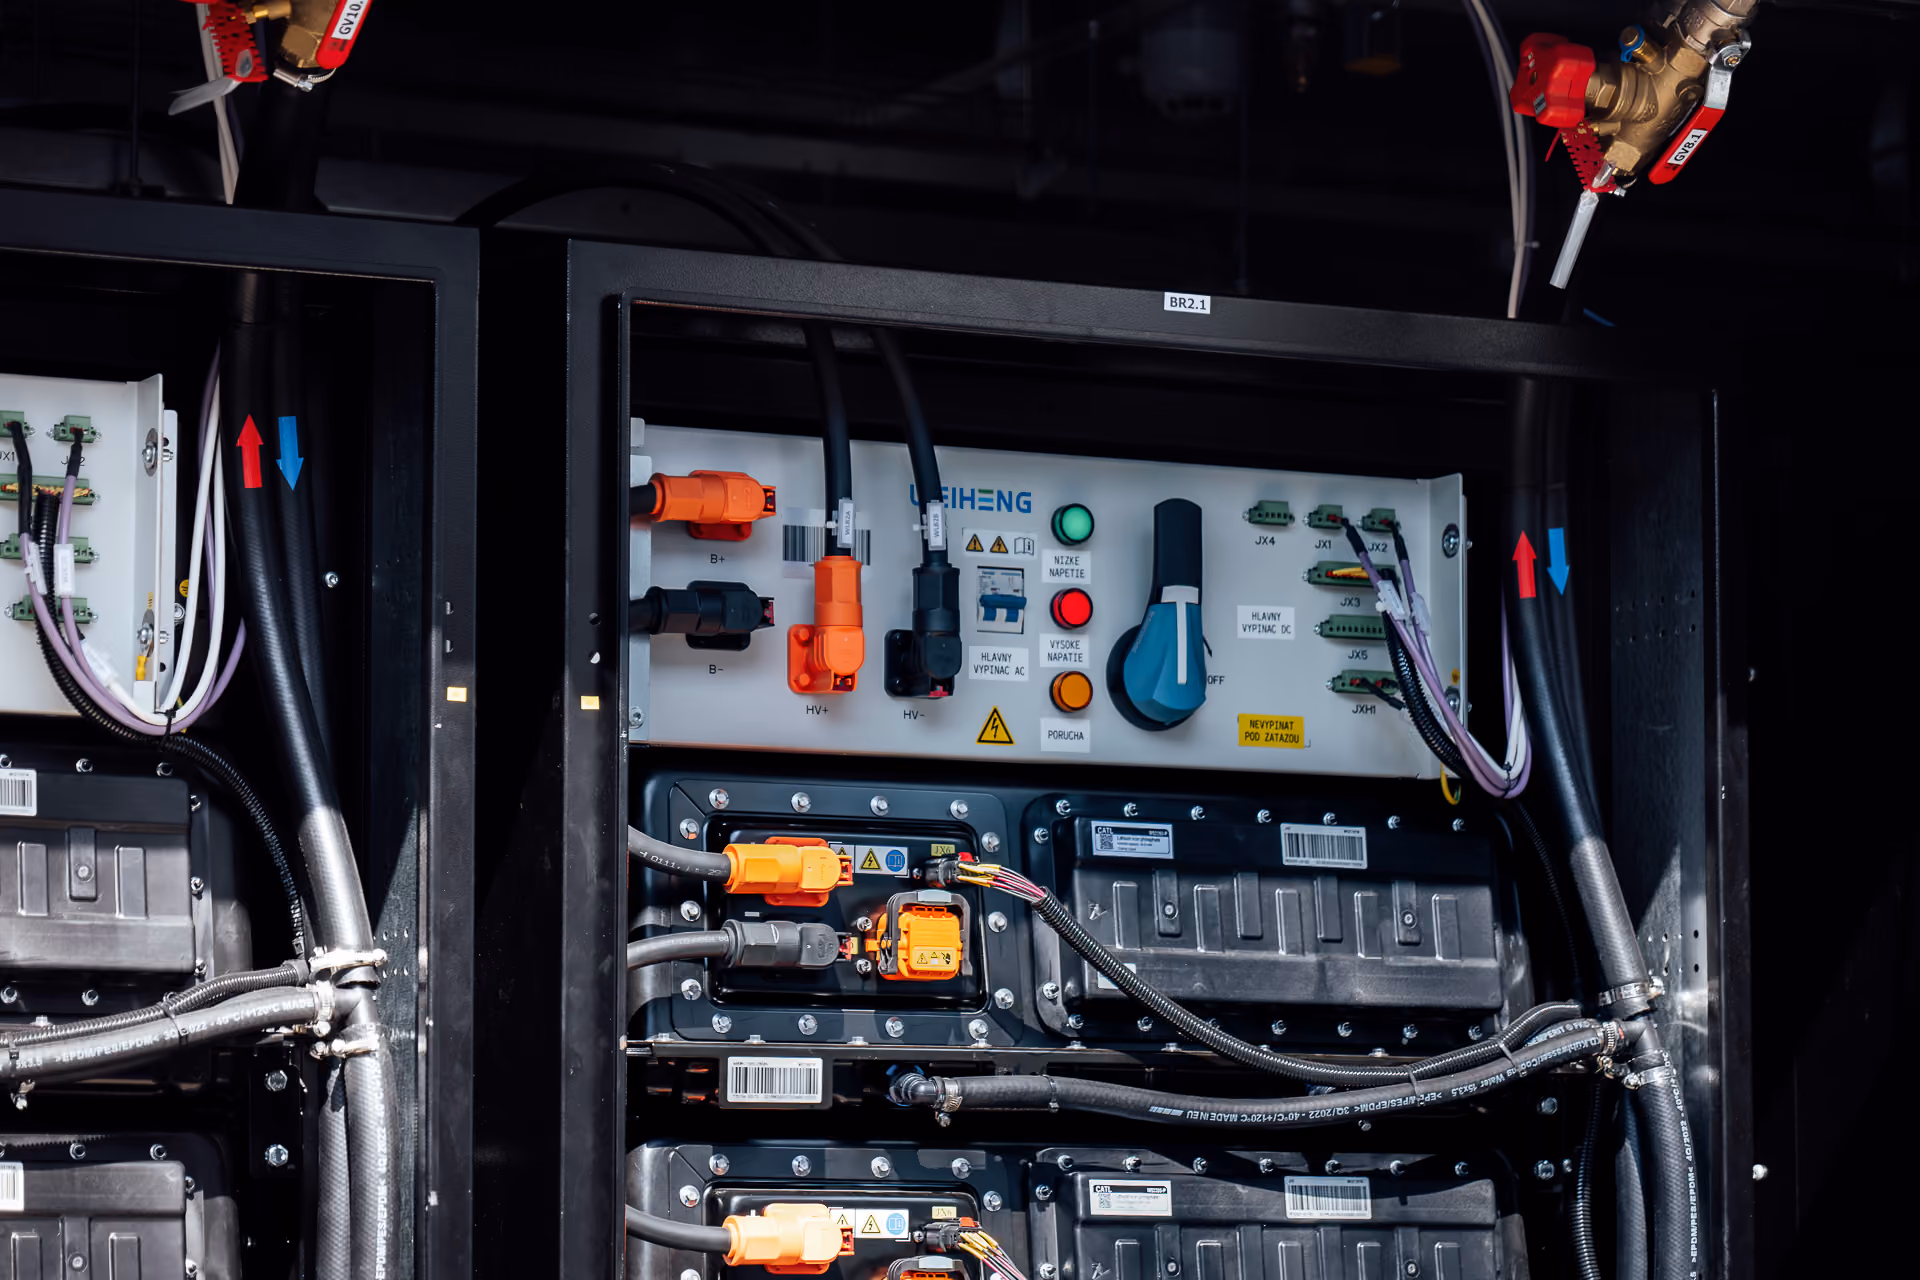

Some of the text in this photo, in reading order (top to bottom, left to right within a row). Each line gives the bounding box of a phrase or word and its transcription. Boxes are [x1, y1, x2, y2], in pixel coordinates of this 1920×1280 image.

[1674, 134, 1703, 162] GV8.1
[1170, 296, 1207, 311] BR2.1
[60, 455, 86, 467] J2
[1255, 536, 1276, 546] JX4
[1315, 540, 1332, 550] JX1
[1368, 543, 1388, 553] JX2
[710, 554, 725, 564] B+
[1054, 555, 1080, 566] NIZKE
[1049, 568, 1085, 579] NAPETIE
[1340, 598, 1361, 608] JX3
[1252, 612, 1281, 622] HLAVNY
[1242, 624, 1291, 635] VYPINAC DC
[1049, 640, 1081, 650] VYSOKE
[981, 652, 1012, 663] HLAVNY
[1047, 652, 1083, 662] NAPATIE
[1348, 650, 1368, 660] JX5
[973, 664, 1025, 676] VYPINAC AC
[1207, 675, 1225, 685] OFF
[806, 705, 829, 715] HV+
[1352, 705, 1376, 715] JXH1
[1249, 720, 1294, 731] NEVYPINAT
[1047, 729, 1084, 741] PORUCHA
[1245, 732, 1300, 744] POD ZATAZOU
[1097, 827, 1114, 835] CATL
[935, 846, 951, 855] JX6
[1480, 1073, 1505, 1089] Water
[1308, 1106, 1350, 1120] 3Q/2022
[1680, 1120, 1693, 1161] 4Q/2022
[1095, 1185, 1113, 1193] CATL
